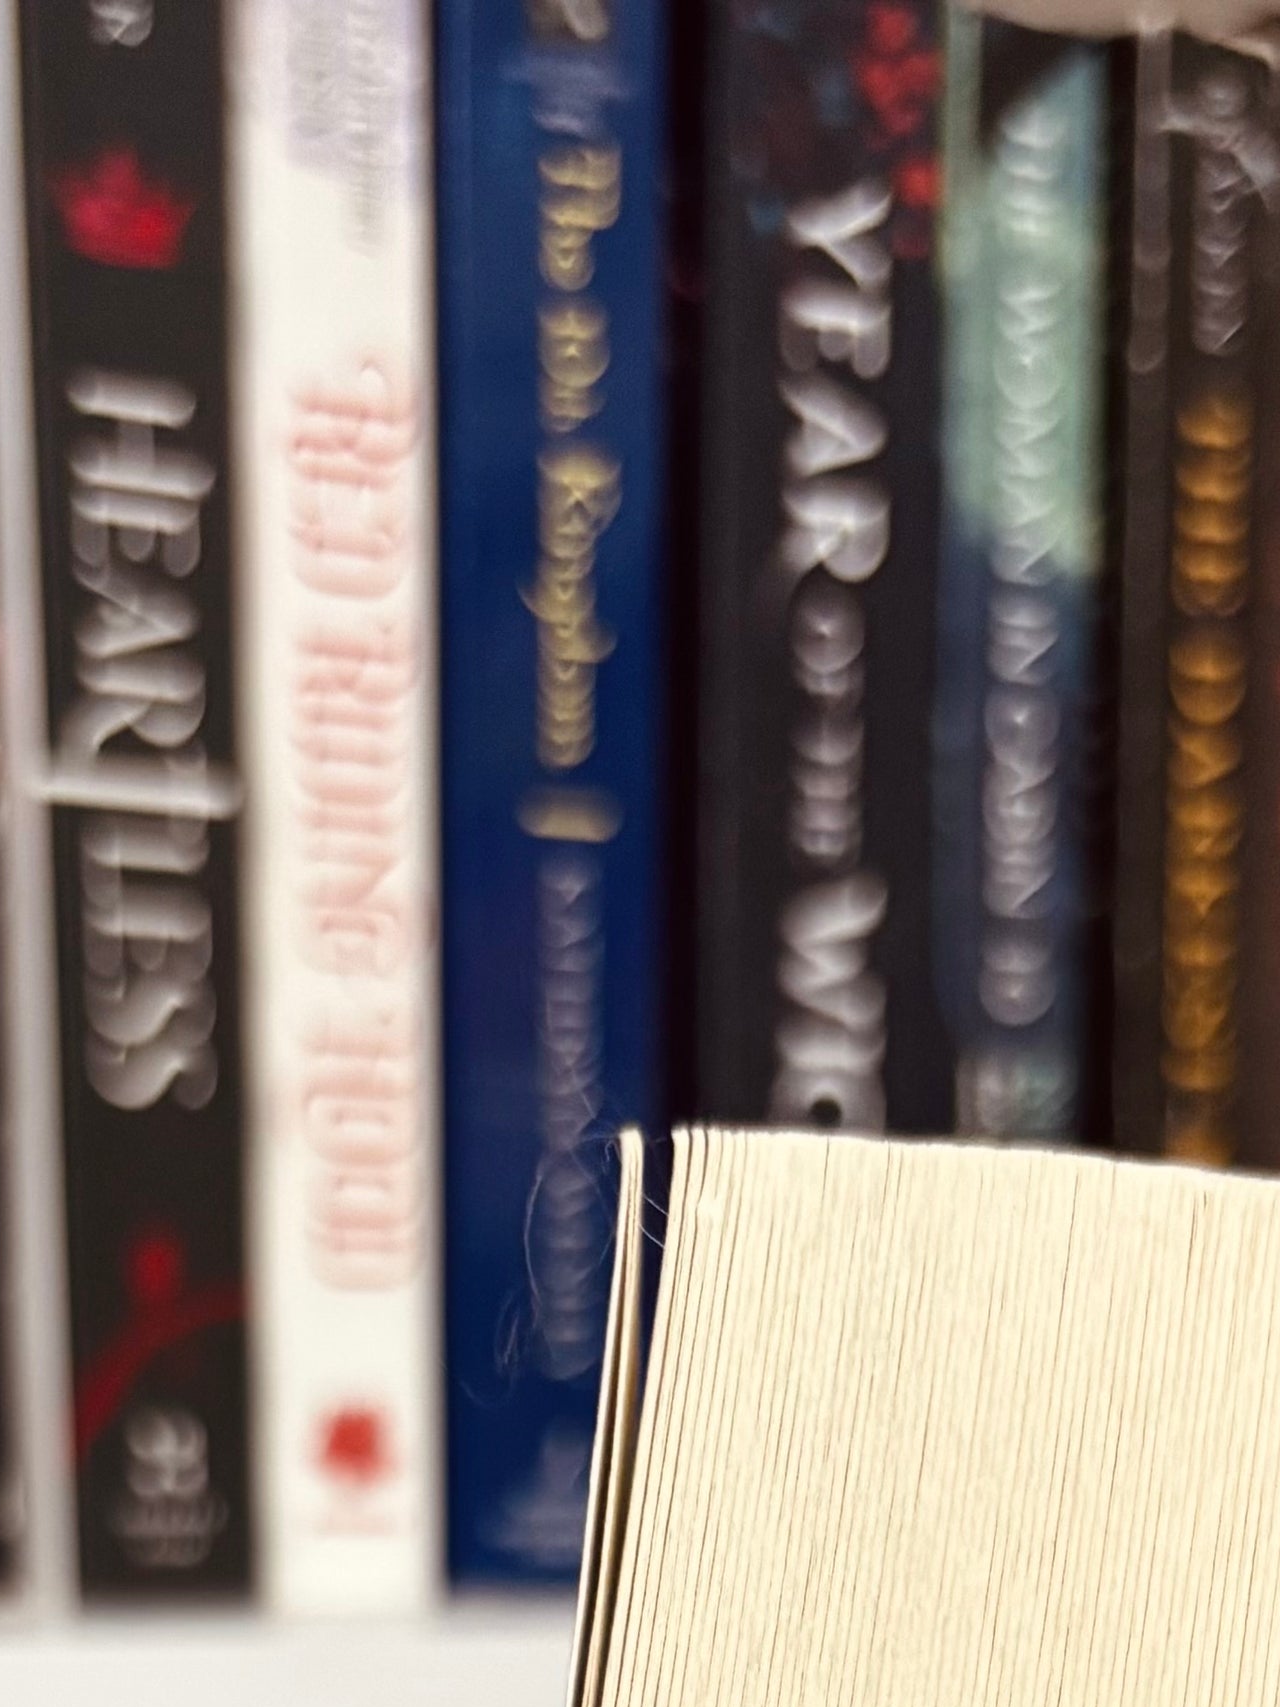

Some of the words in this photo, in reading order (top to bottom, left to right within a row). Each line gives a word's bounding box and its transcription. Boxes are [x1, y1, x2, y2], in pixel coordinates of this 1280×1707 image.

[288, 358, 422, 600] RED
[778, 176, 892, 585] YEAR
[990, 275, 1065, 588] WOMAN
[36, 367, 243, 1110] HEARTLESS
